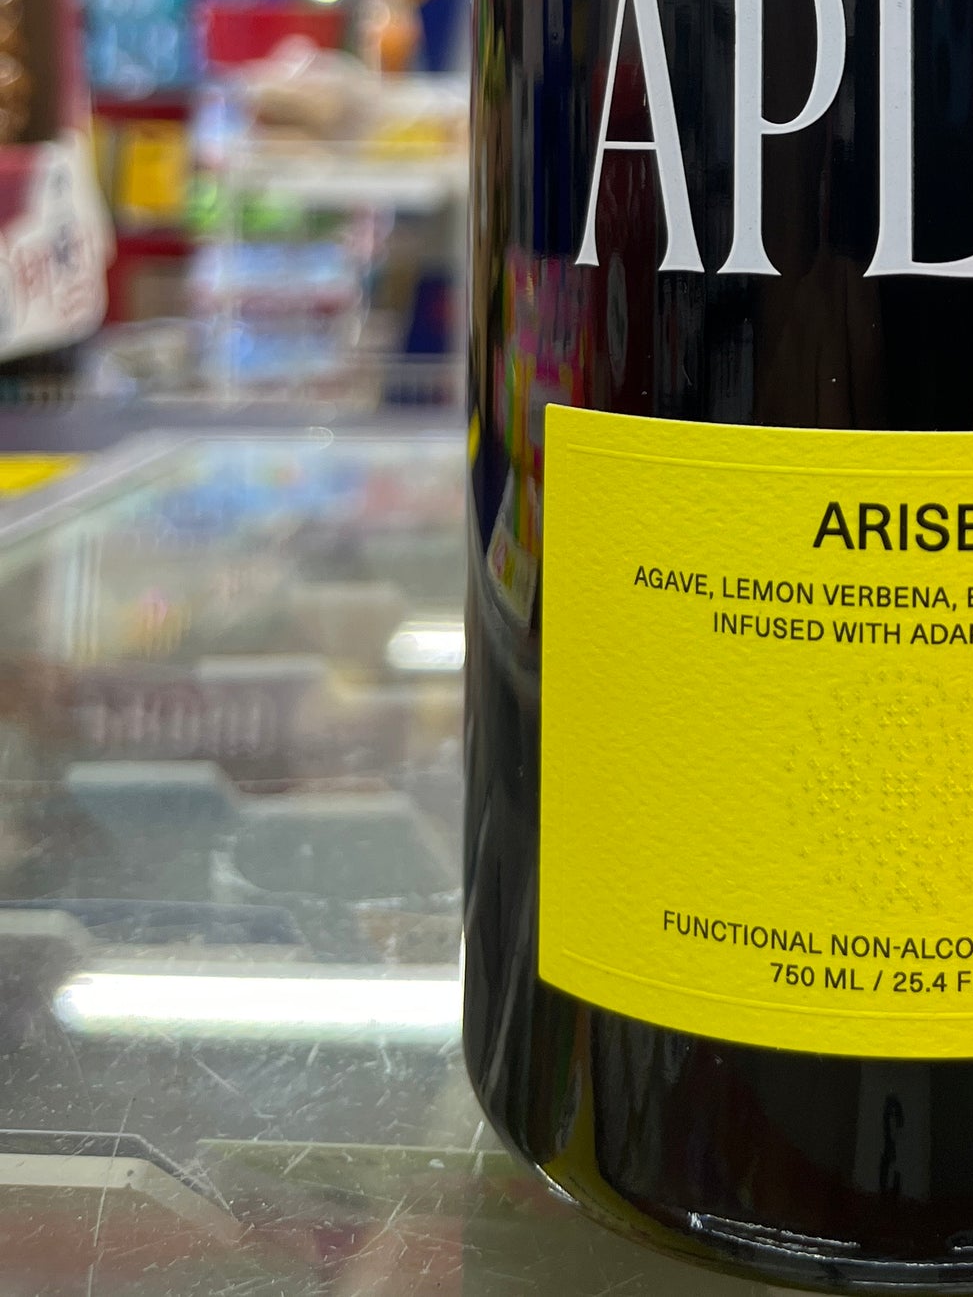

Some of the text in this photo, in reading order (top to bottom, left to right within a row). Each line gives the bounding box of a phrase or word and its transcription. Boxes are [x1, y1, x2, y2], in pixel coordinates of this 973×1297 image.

[632, 564, 715, 602] AGAVE,
[721, 575, 815, 606] LEMON
[821, 583, 958, 613] VERBENA,
[711, 610, 826, 642] INFUSED
[831, 620, 902, 646] WITH
[662, 909, 823, 956] FUNCTIONAL
[769, 961, 816, 988] 750
[823, 966, 865, 992] ML
[872, 969, 884, 993] /
[892, 970, 948, 994] 25.4
